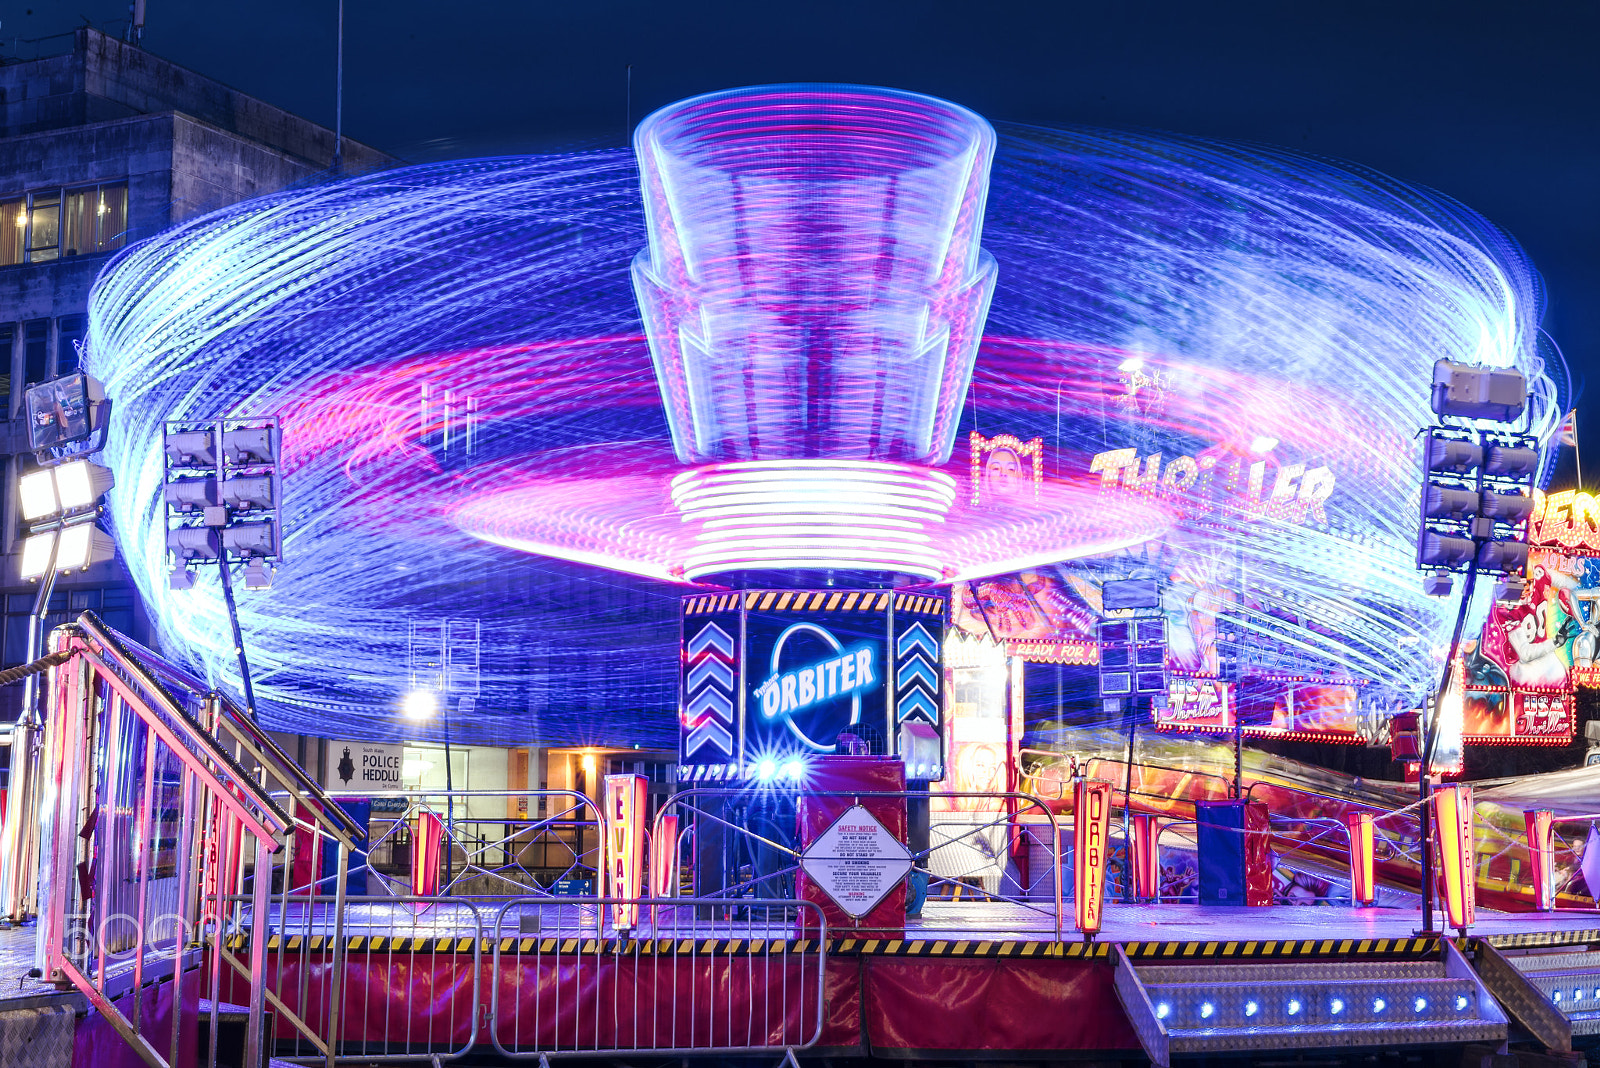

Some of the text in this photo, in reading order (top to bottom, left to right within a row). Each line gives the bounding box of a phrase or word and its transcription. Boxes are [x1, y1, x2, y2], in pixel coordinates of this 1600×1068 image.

[1089, 447, 1336, 526] THRILLER
[1016, 643, 1056, 656] READY
[1061, 645, 1085, 658] FOR
[1089, 647, 1097, 658] A
[762, 648, 874, 718] ORBITER
[1169, 678, 1219, 703] USA
[1161, 697, 1224, 721] Thriller
[1523, 695, 1567, 718] USA
[1515, 711, 1570, 735] Thriller
[362, 755, 399, 768] POLICE
[362, 769, 399, 782] HEDDLU
[1087, 790, 1103, 921] ORBITER
